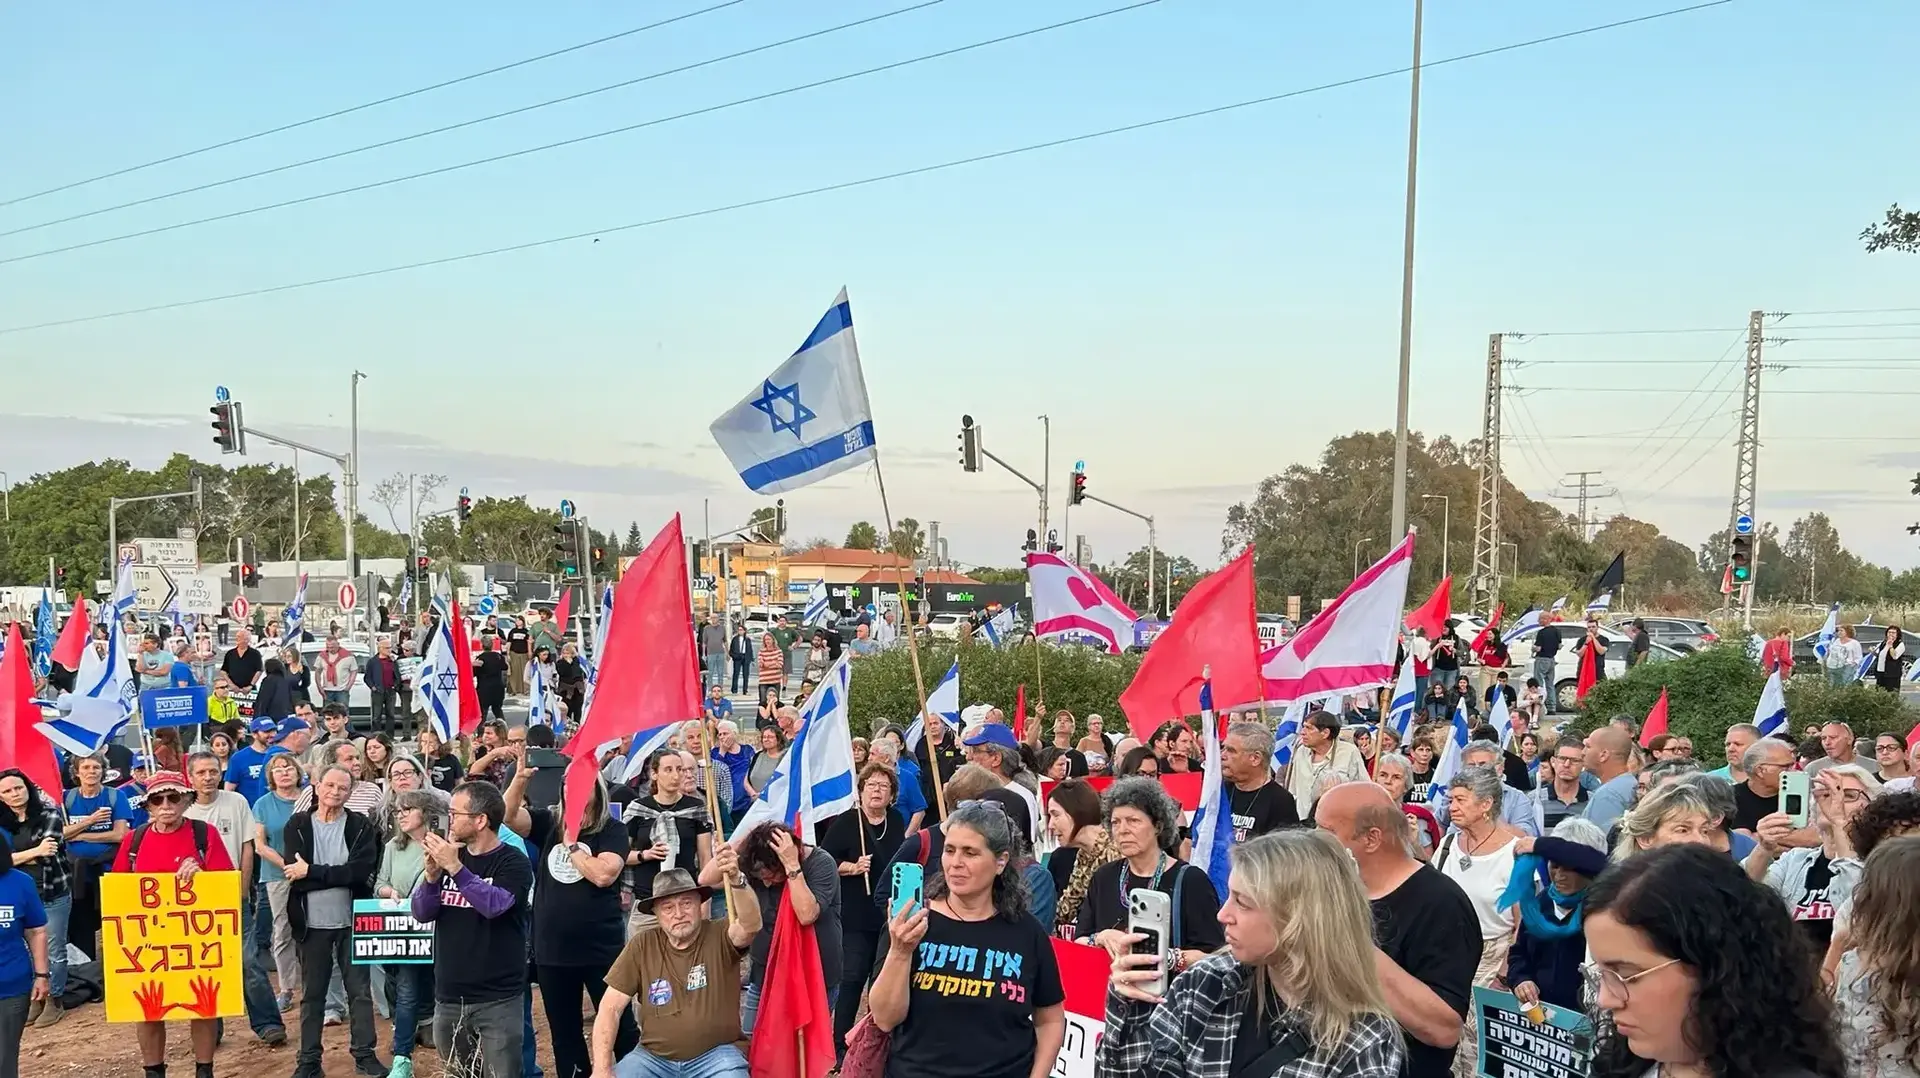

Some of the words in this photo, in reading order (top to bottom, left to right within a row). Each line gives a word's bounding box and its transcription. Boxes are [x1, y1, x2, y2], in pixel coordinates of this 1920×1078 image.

[132, 571, 150, 580] חדר
[946, 592, 975, 602] EuroDrive
[355, 916, 383, 932] הורג
[355, 938, 406, 956] השלום
[408, 939, 431, 955] את
[983, 949, 1022, 980] אין
[1000, 980, 1025, 1003] בלי
[1498, 1009, 1518, 1023] פה
[1520, 1016, 1554, 1037] תהה
[1489, 1021, 1583, 1070] דמוקרטיה
[1501, 1045, 1548, 1073] שנעשה
[1550, 1065, 1569, 1078] עד
